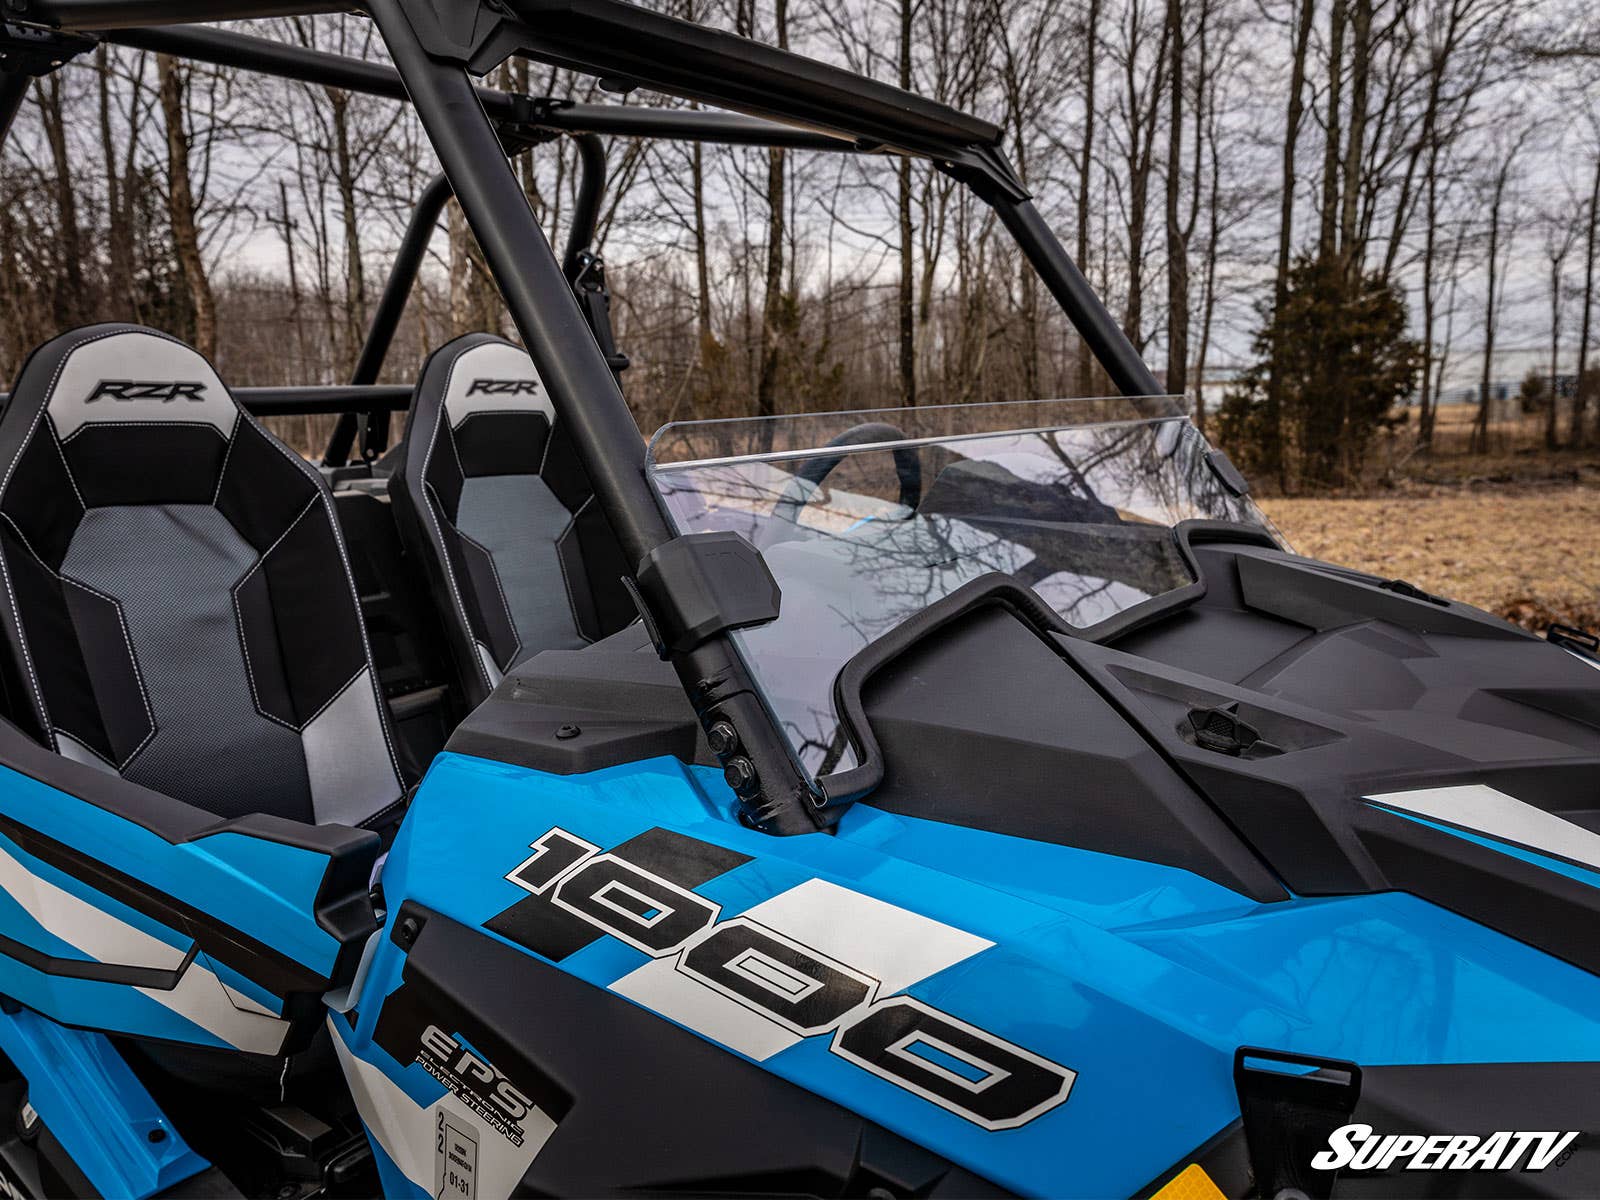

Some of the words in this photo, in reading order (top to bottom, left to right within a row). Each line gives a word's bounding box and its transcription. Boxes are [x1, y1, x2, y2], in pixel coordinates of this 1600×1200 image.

[84, 379, 207, 403] RZR
[465, 379, 538, 397] RZR
[504, 826, 1077, 1132] 1000
[415, 1055, 459, 1093] POWER
[460, 1092, 523, 1147] STEERING
[420, 1024, 532, 1118] EPS
[420, 1050, 523, 1135] ELECTRONIC
[450, 1171, 469, 1196] 01-31
